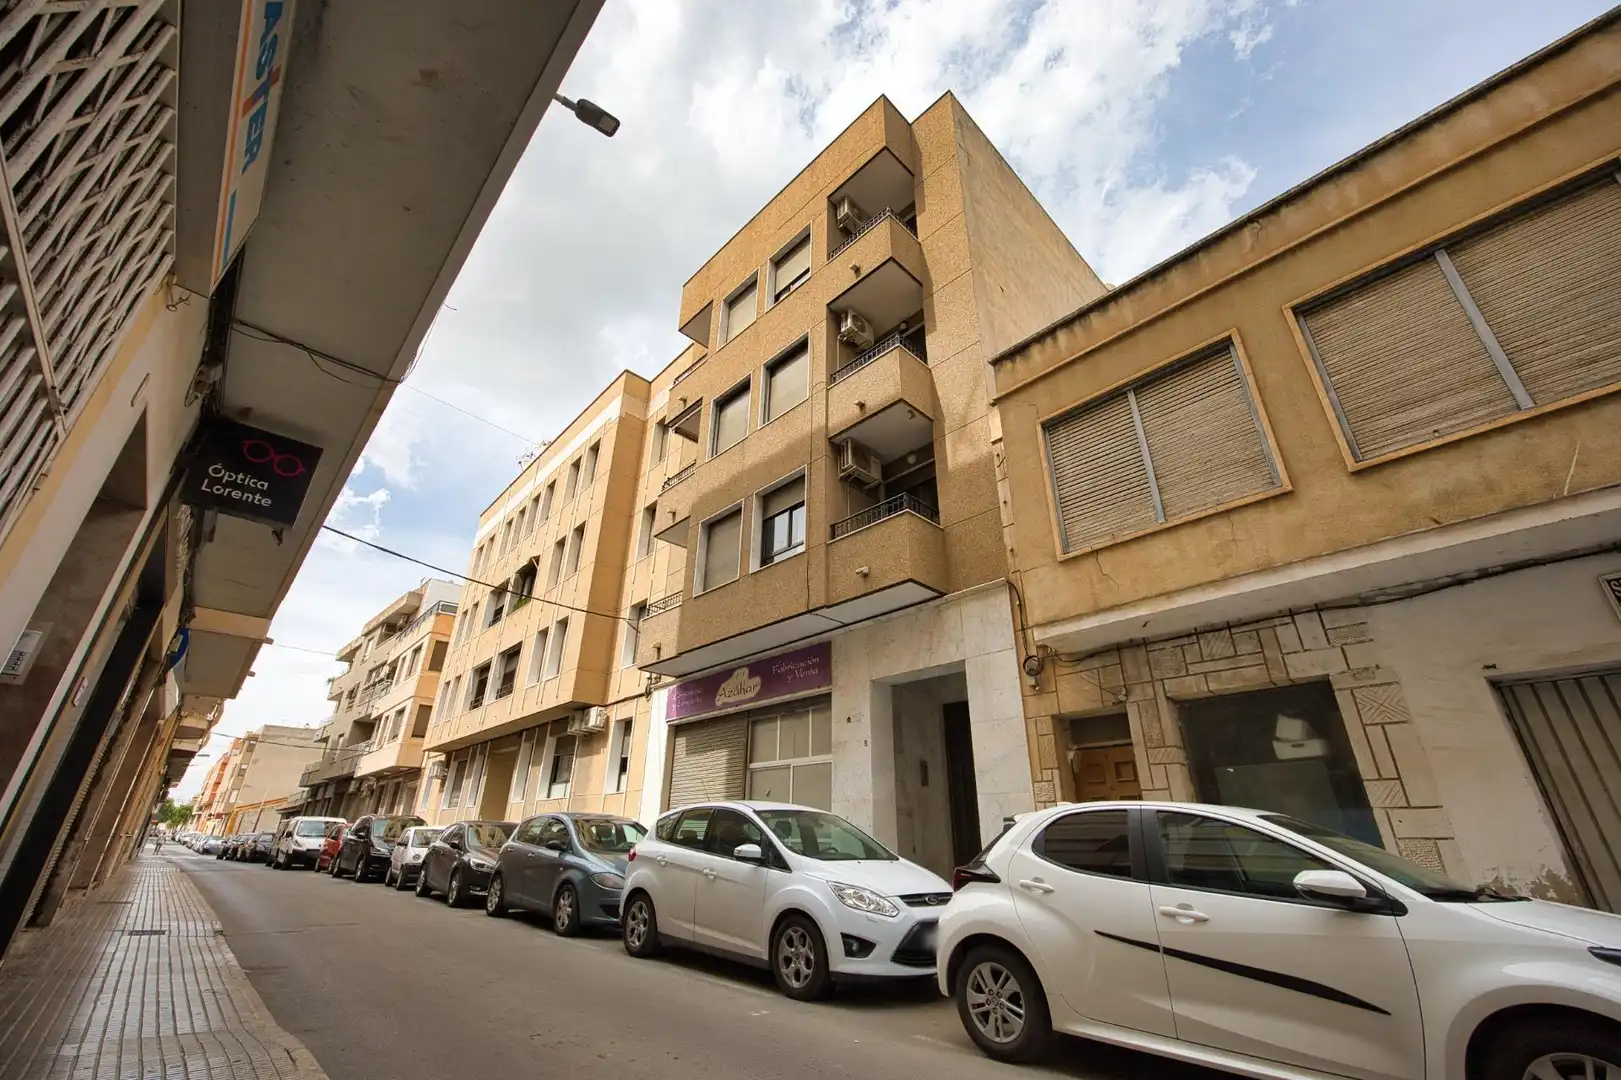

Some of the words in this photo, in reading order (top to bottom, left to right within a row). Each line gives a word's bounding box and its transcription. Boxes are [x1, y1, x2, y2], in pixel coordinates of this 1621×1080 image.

[208, 462, 269, 491] Óptica
[201, 478, 272, 507] Lorente
[771, 656, 820, 675] Fabricación
[787, 674, 793, 683] y
[795, 667, 819, 679] Venta
